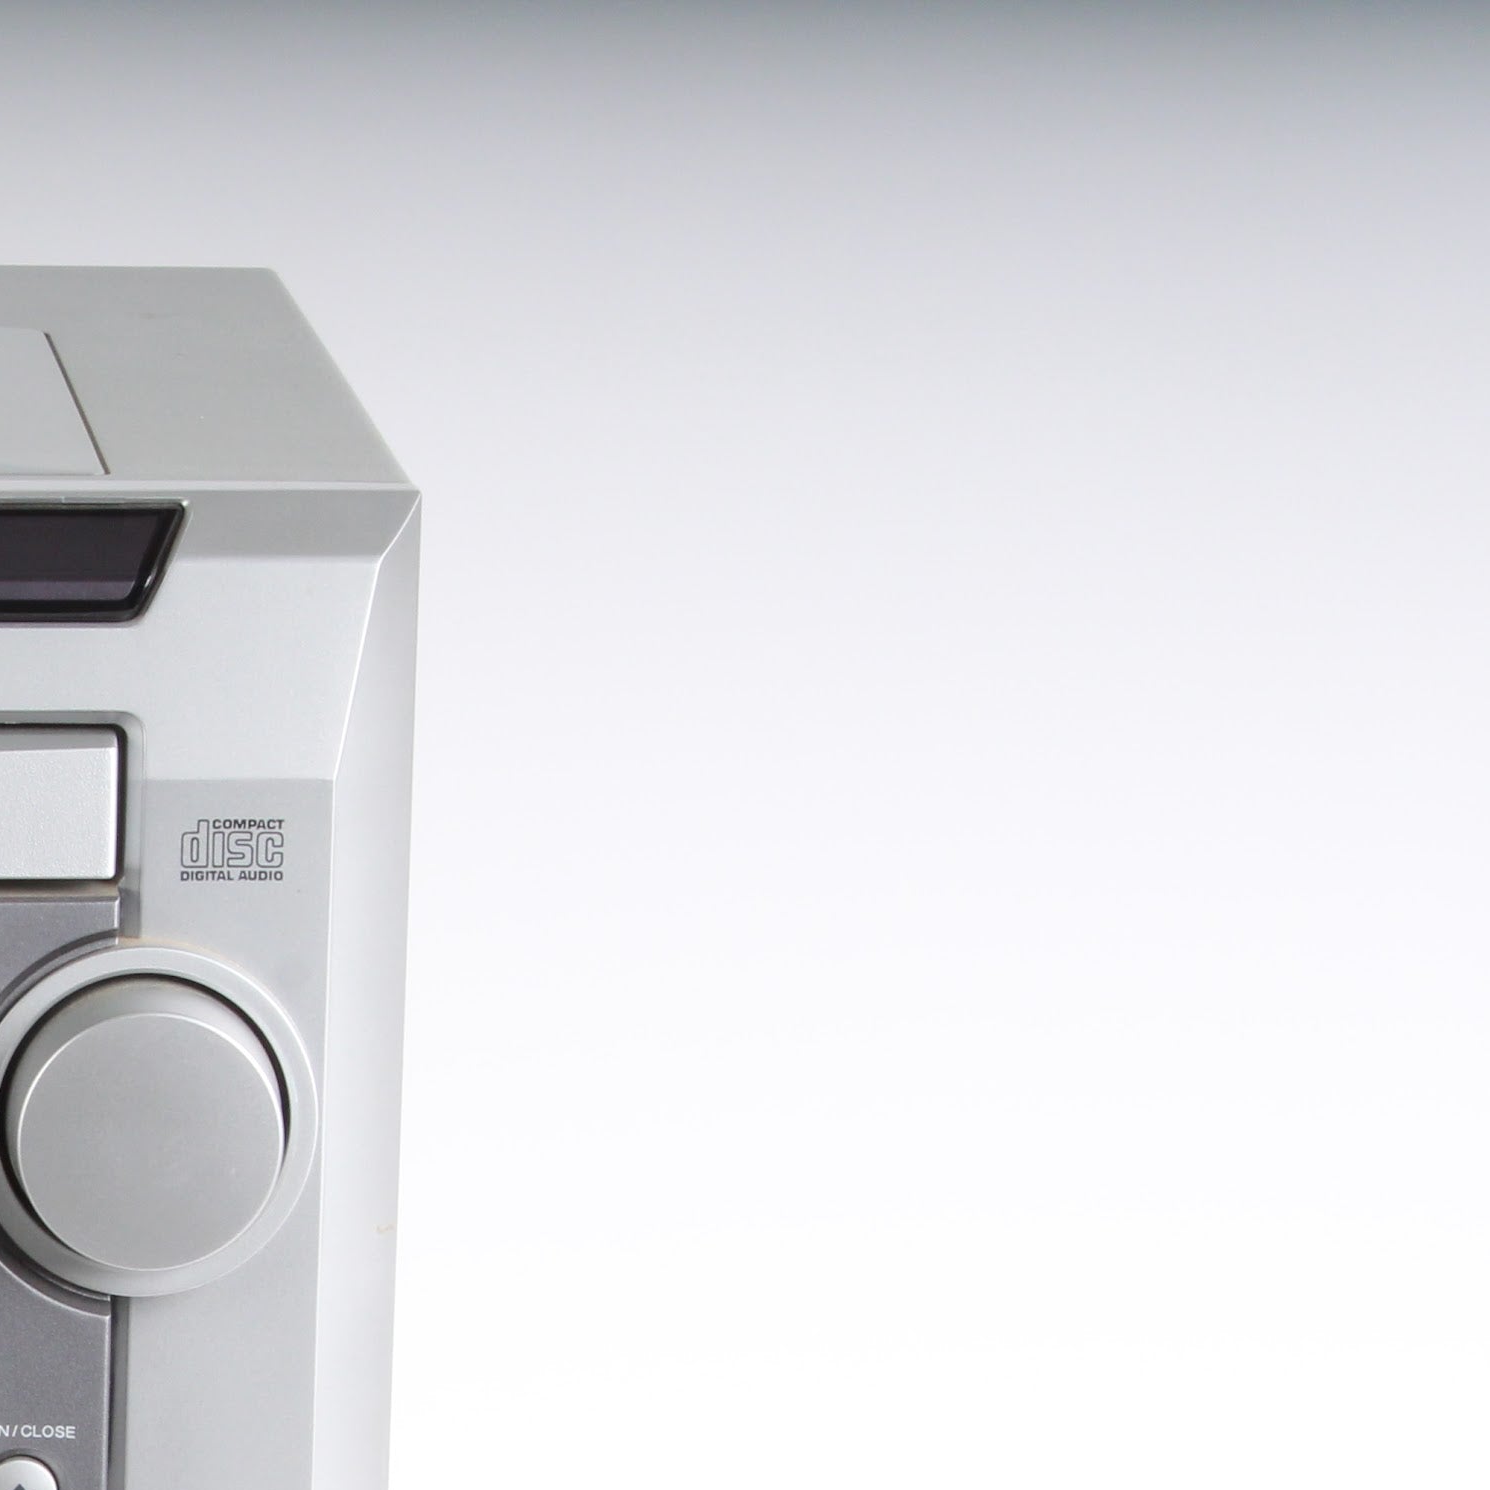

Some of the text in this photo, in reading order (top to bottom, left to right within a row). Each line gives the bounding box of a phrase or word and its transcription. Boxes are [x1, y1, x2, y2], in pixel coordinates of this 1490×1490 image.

[212, 819, 284, 830] COMPACT
[181, 870, 284, 881] DIGITAL AUDIO
